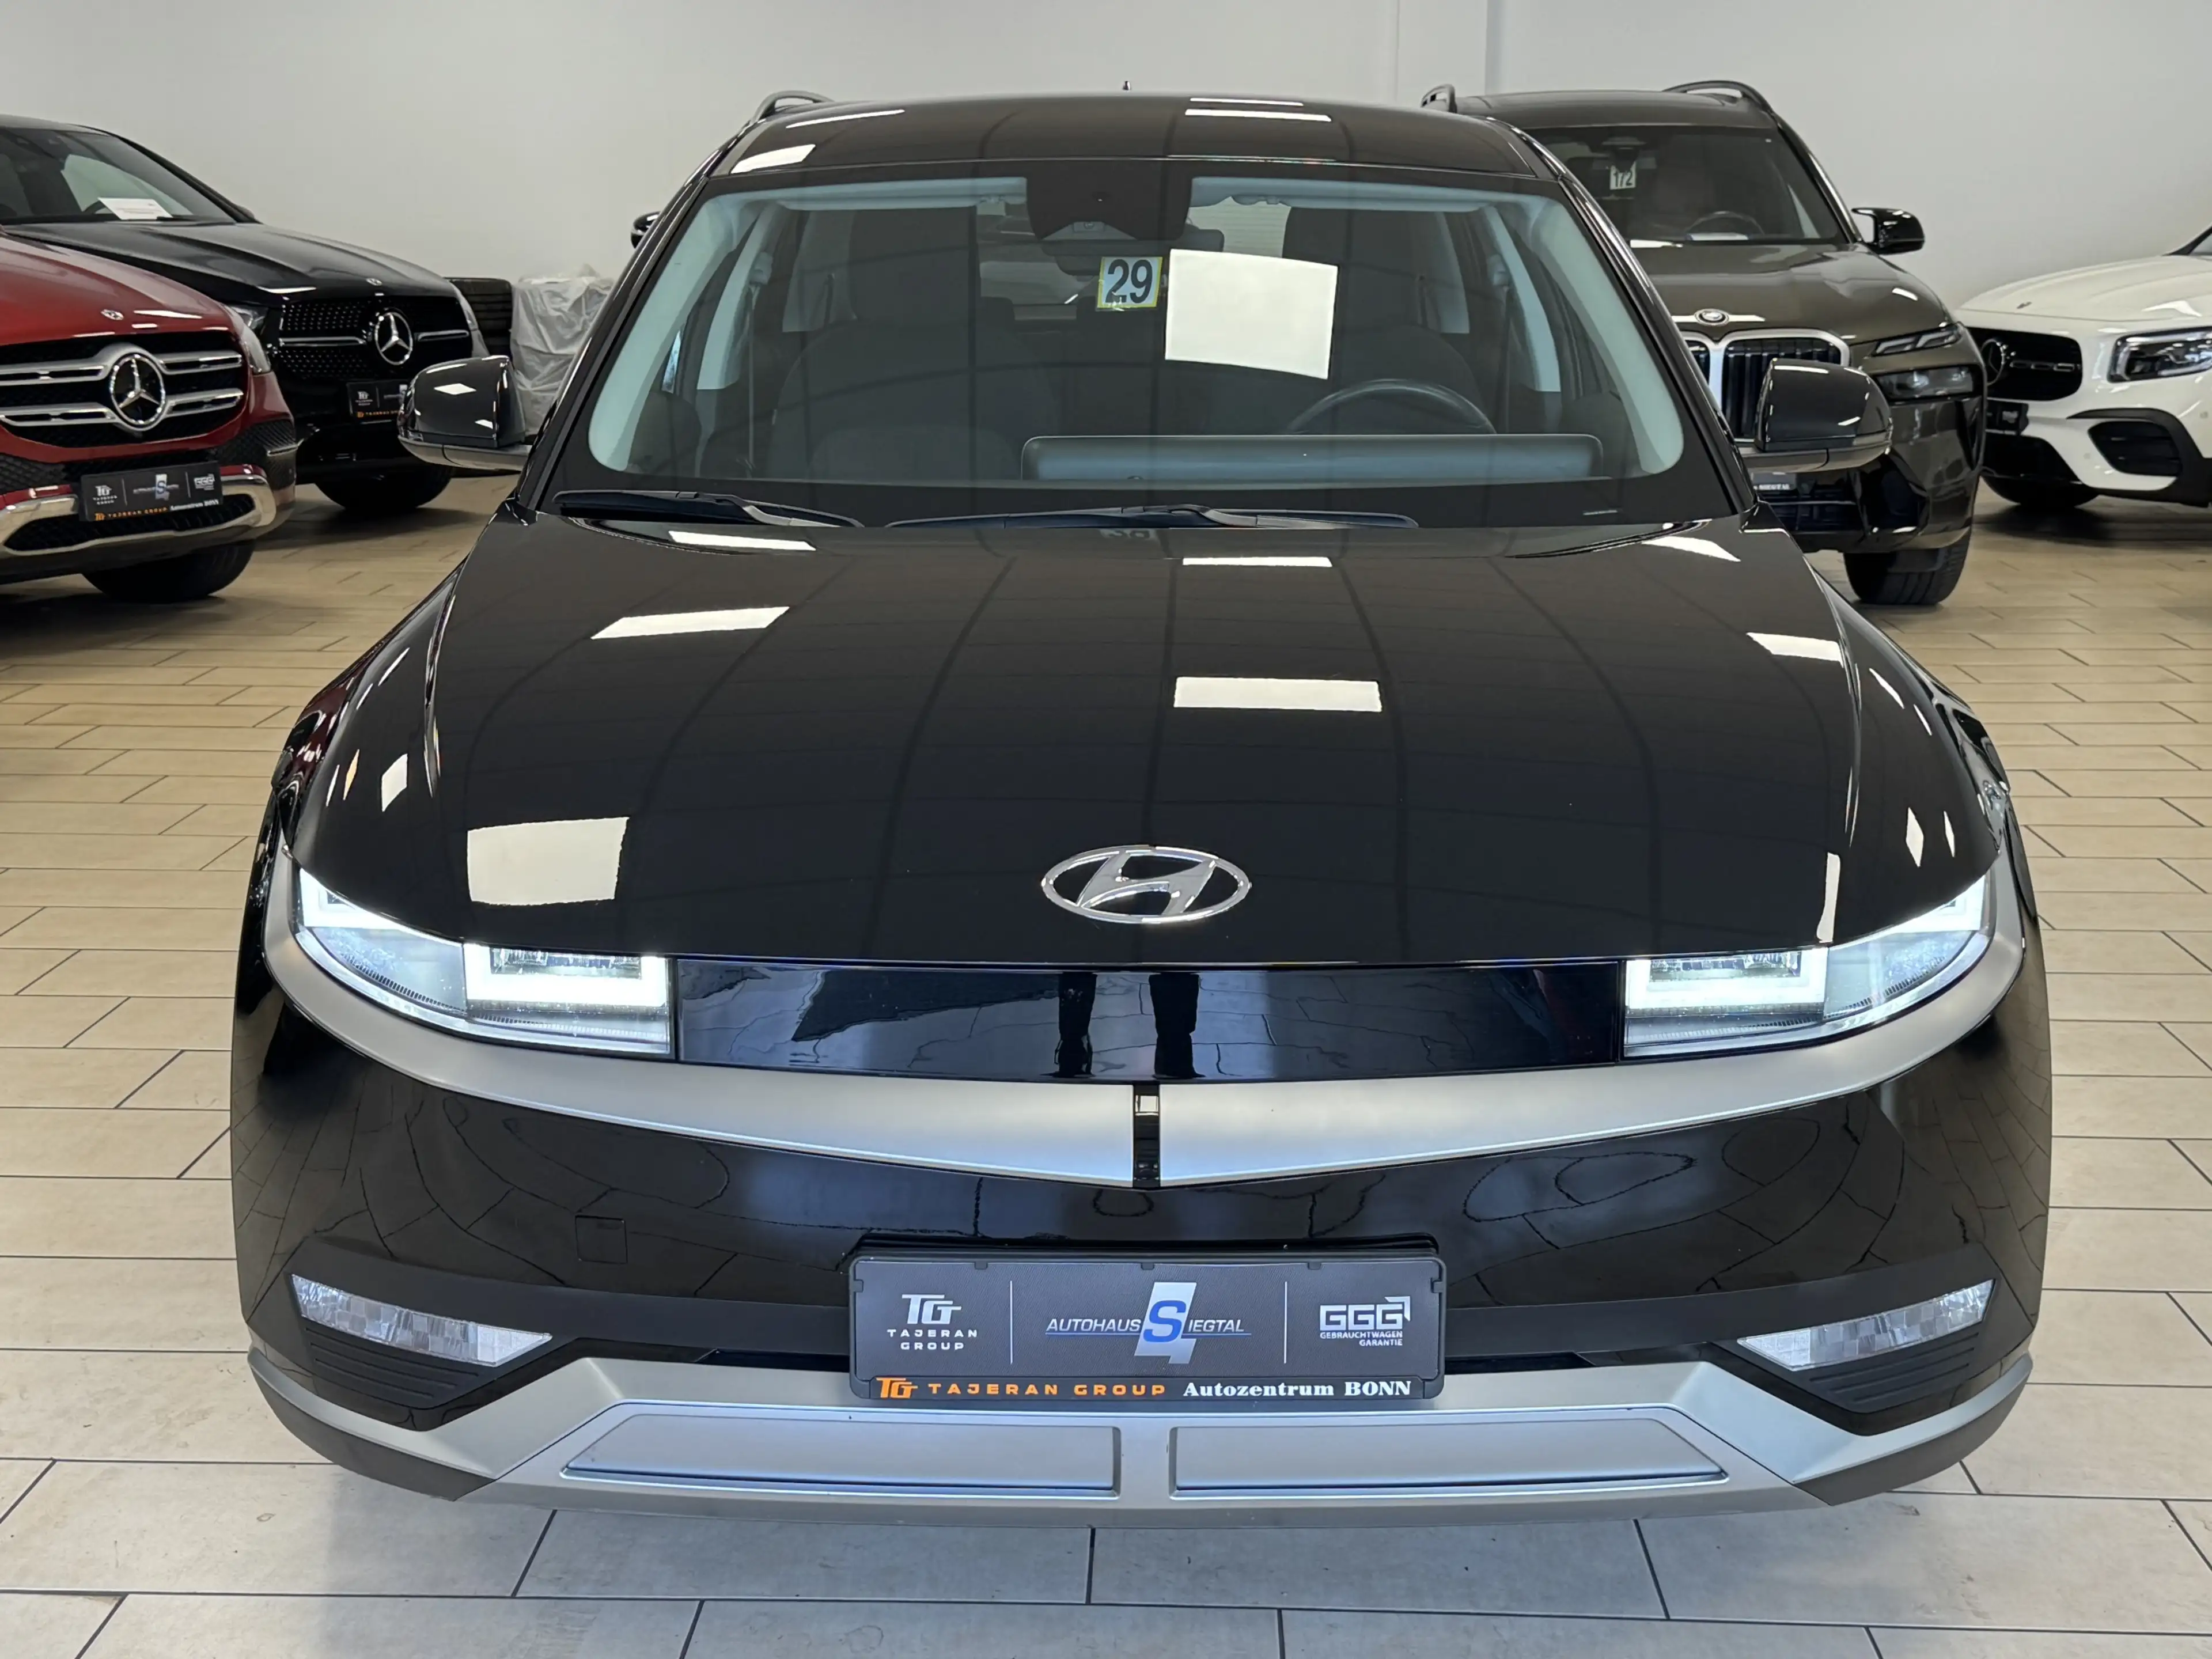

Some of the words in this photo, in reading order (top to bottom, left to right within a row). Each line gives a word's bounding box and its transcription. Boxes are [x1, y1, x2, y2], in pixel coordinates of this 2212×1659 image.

[1105, 259, 1153, 304] 29
[902, 1294, 961, 1324] TG
[1320, 1304, 1403, 1331] GGG
[1046, 1318, 1142, 1332] AUTOHAUS
[887, 1328, 978, 1338] TAJERAN
[1320, 1331, 1403, 1339] GEBRAUCHTWAGEN
[900, 1342, 964, 1350] GROUP
[1359, 1339, 1403, 1347] GARANTIE
[876, 1377, 918, 1399] TG
[928, 1383, 1059, 1395] TAJERAN
[1074, 1384, 1166, 1396] GROUP
[1183, 1381, 1334, 1397] Autozentrum
[1344, 1381, 1412, 1396] BONN
